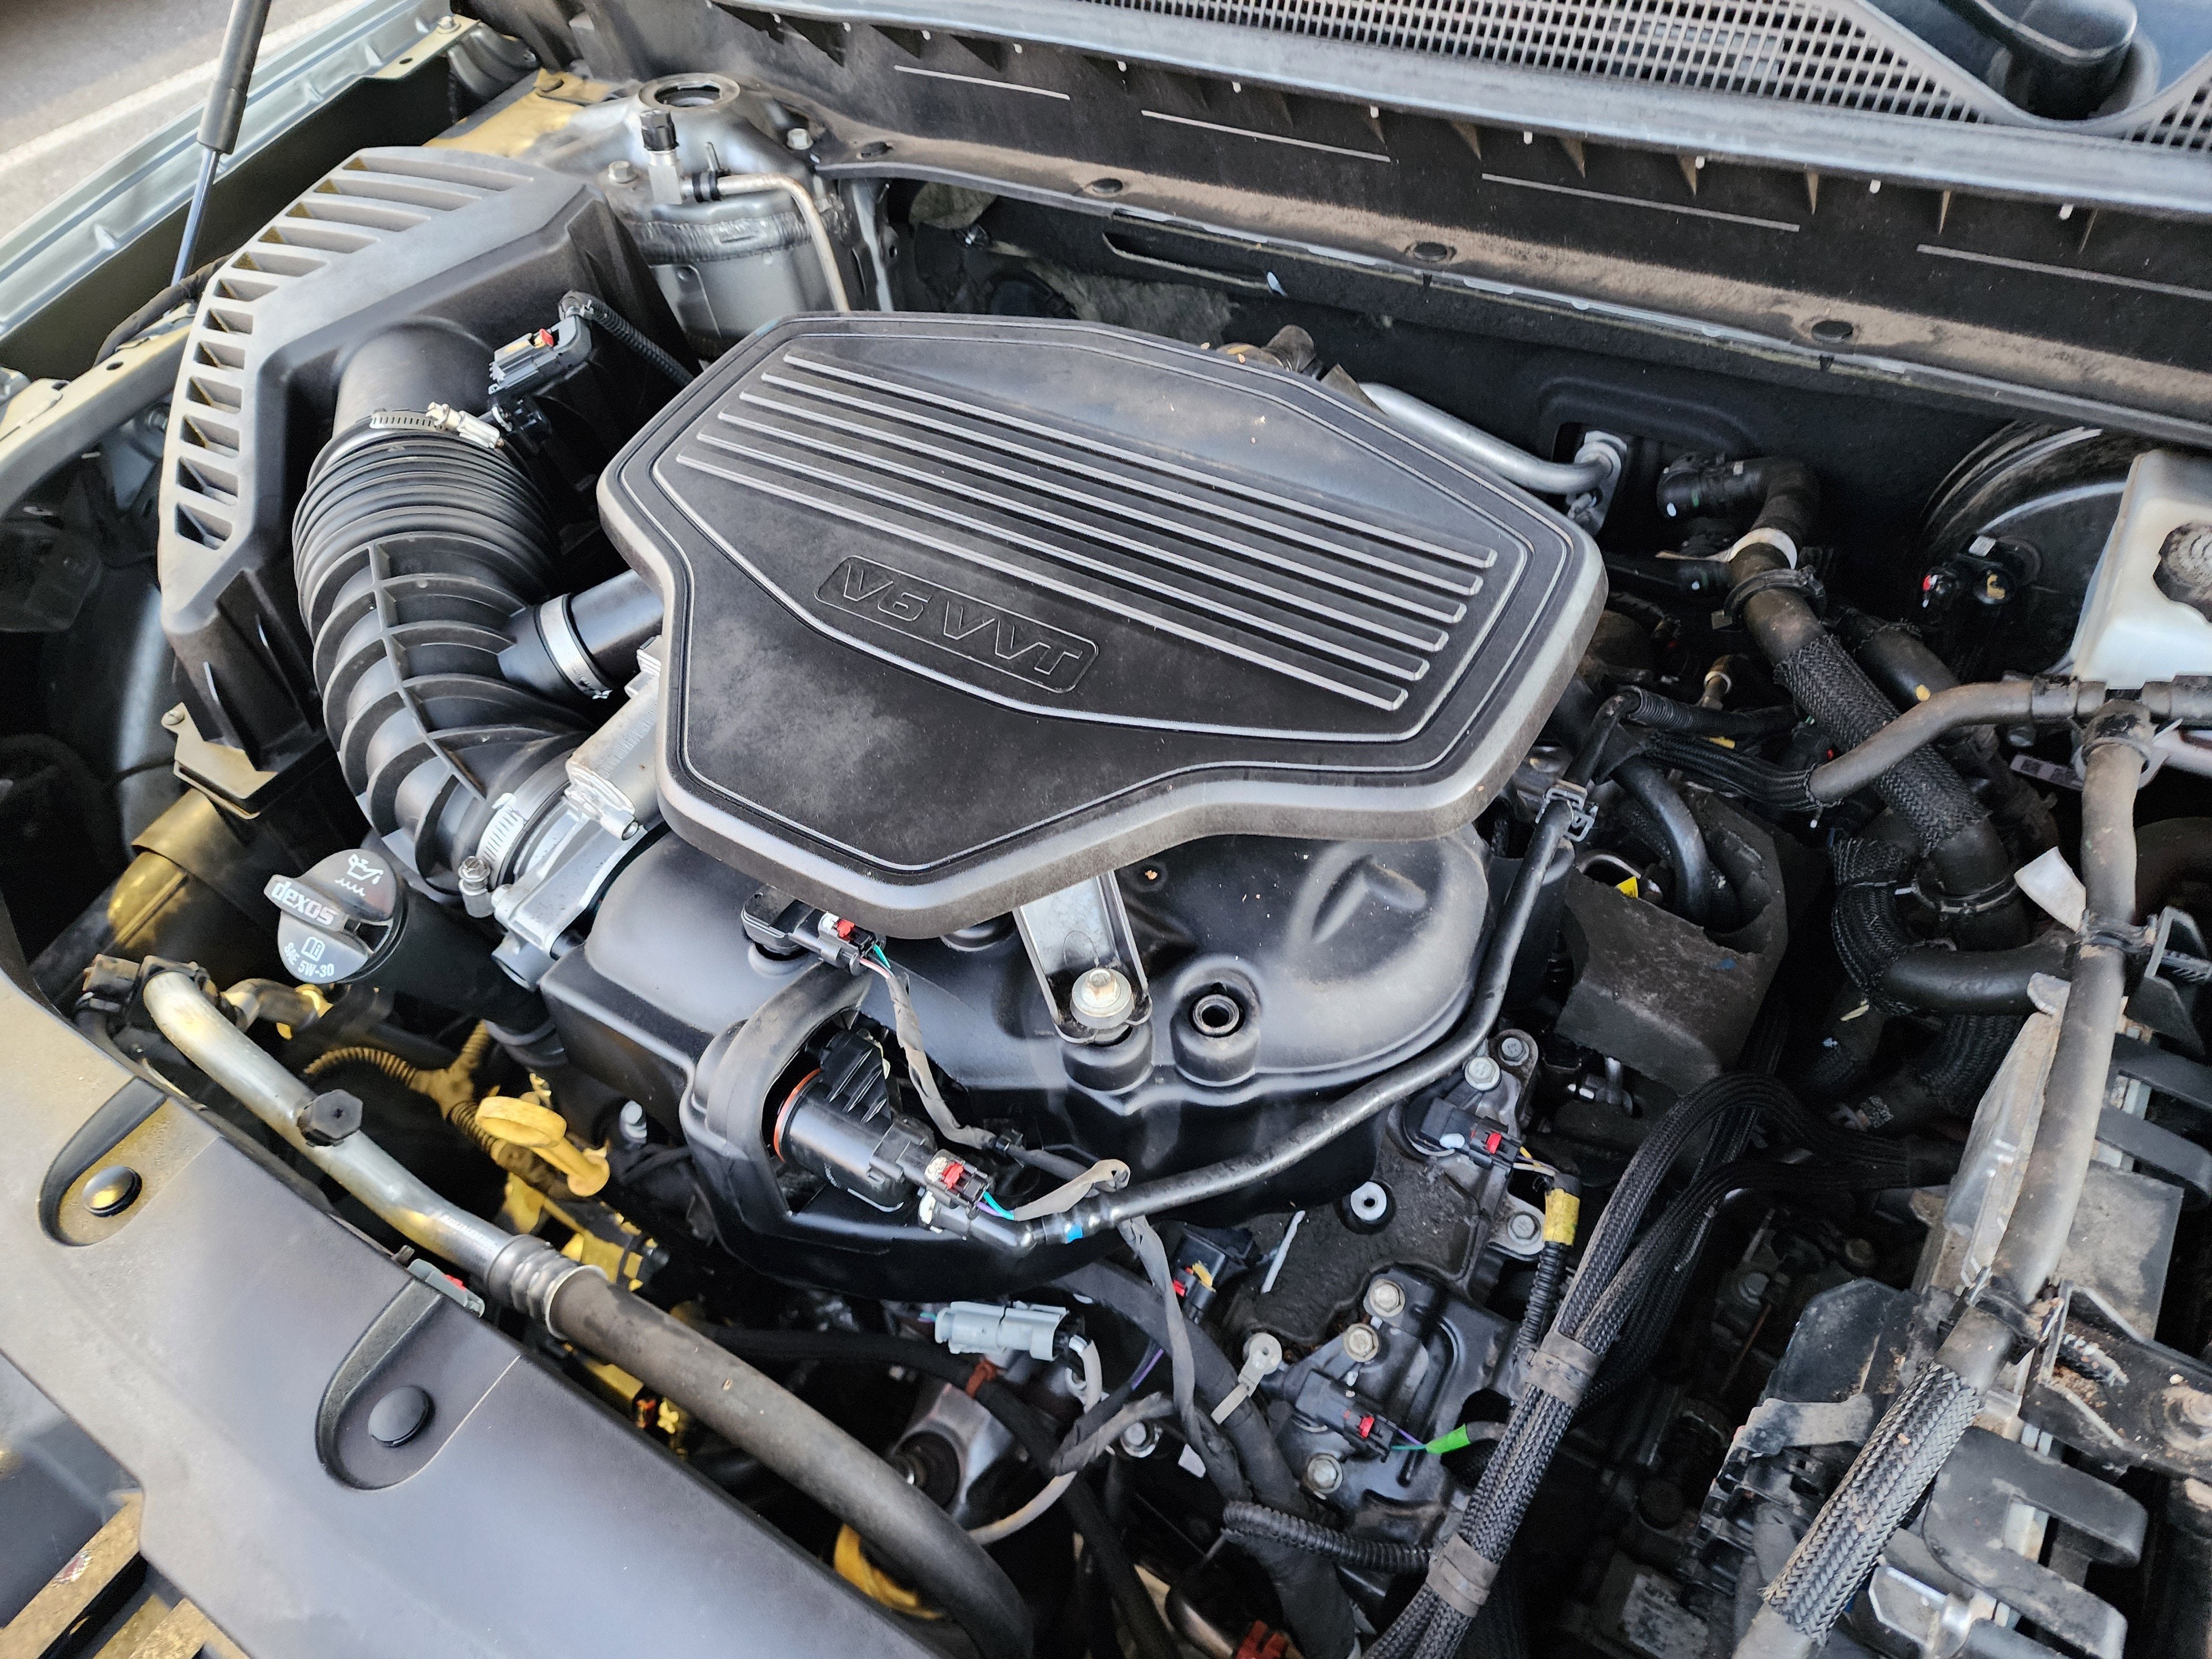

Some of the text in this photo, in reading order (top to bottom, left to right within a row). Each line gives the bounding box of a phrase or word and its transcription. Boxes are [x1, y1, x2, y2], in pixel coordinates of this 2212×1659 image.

[843, 564, 1083, 675] V6 VVT
[271, 880, 339, 926] dexos
[284, 942, 335, 978] SAE 5W-30
